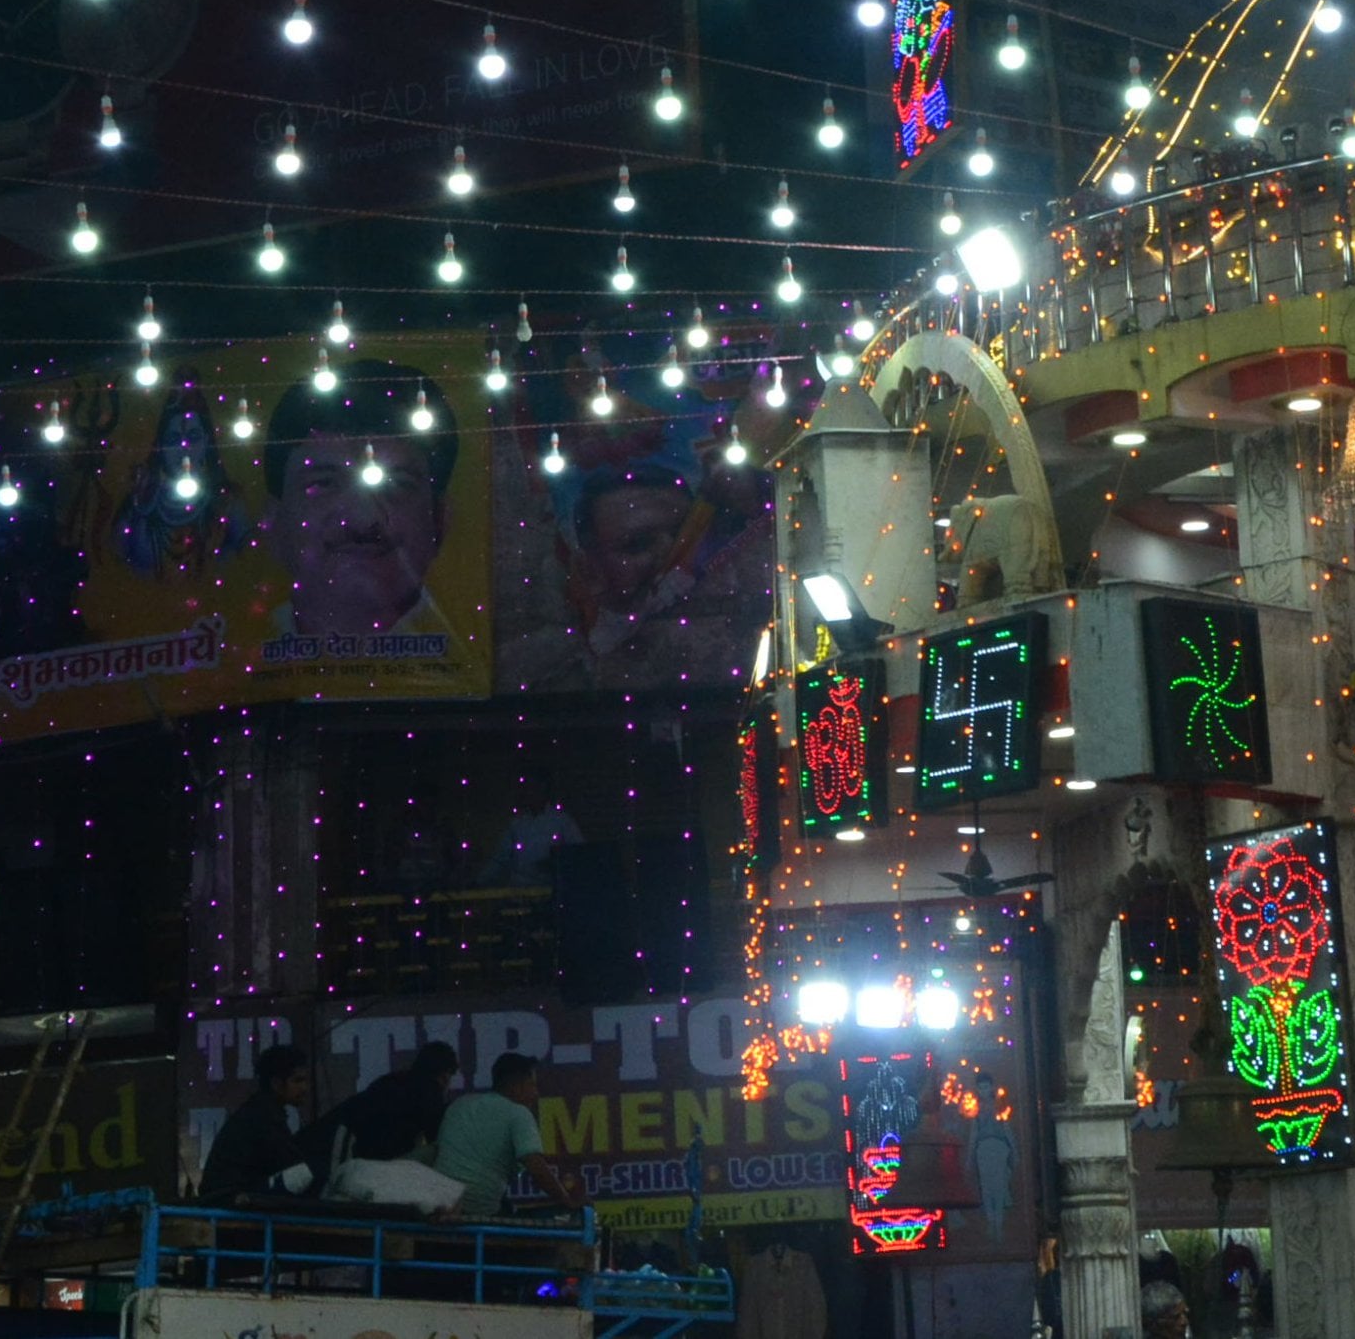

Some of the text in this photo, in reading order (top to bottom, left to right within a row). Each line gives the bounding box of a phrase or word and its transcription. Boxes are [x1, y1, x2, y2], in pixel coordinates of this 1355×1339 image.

[533, 55, 568, 90] IN
[262, 632, 319, 660] कपिल
[365, 633, 447, 659] अग्रवाल
[330, 998, 813, 1094] TIP-TO
[536, 1080, 835, 1155] MENTS
